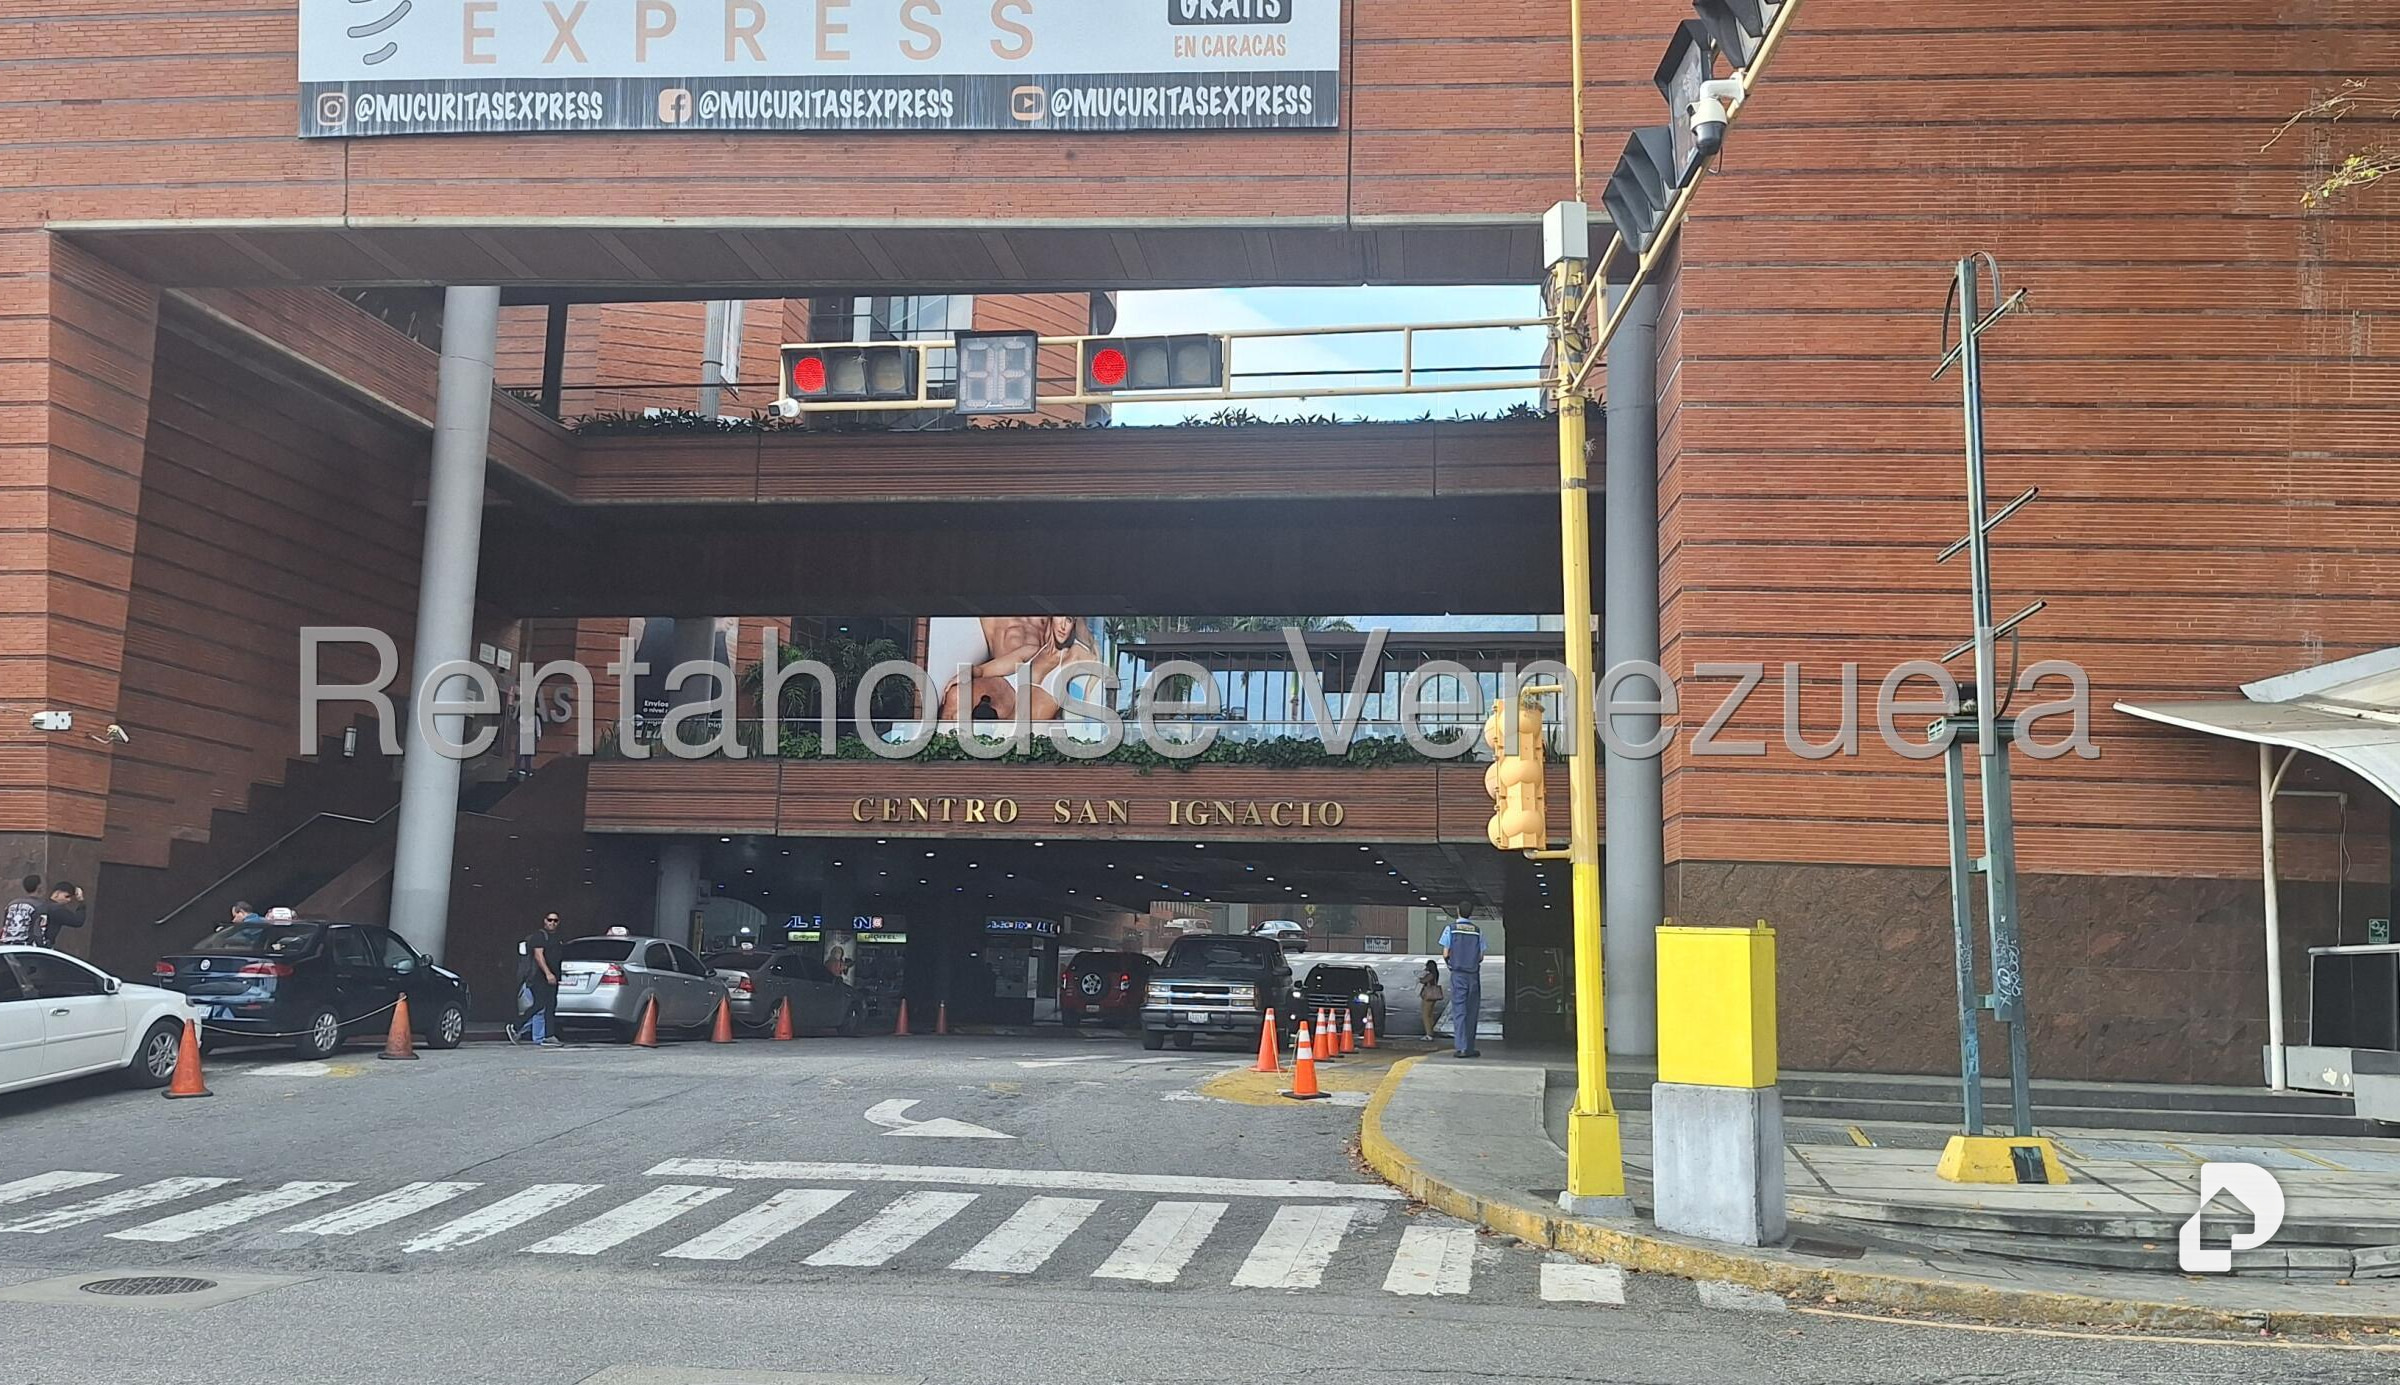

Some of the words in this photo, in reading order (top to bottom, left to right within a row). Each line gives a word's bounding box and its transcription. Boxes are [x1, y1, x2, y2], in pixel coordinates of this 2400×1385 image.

[462, 0, 1034, 65] EXPRESS
[1174, 35, 1197, 58] EN
[1201, 34, 1286, 58] CARACAS
[354, 89, 604, 123] @MUCURITASEXPRESS
[698, 86, 954, 121] @MUCURITASEXPRESS
[1050, 85, 1312, 119] @MUCURITASEXPRESS
[852, 797, 1019, 825] CENTRO
[1054, 798, 1130, 825] SAN
[1169, 799, 1346, 827] IGNACIO
